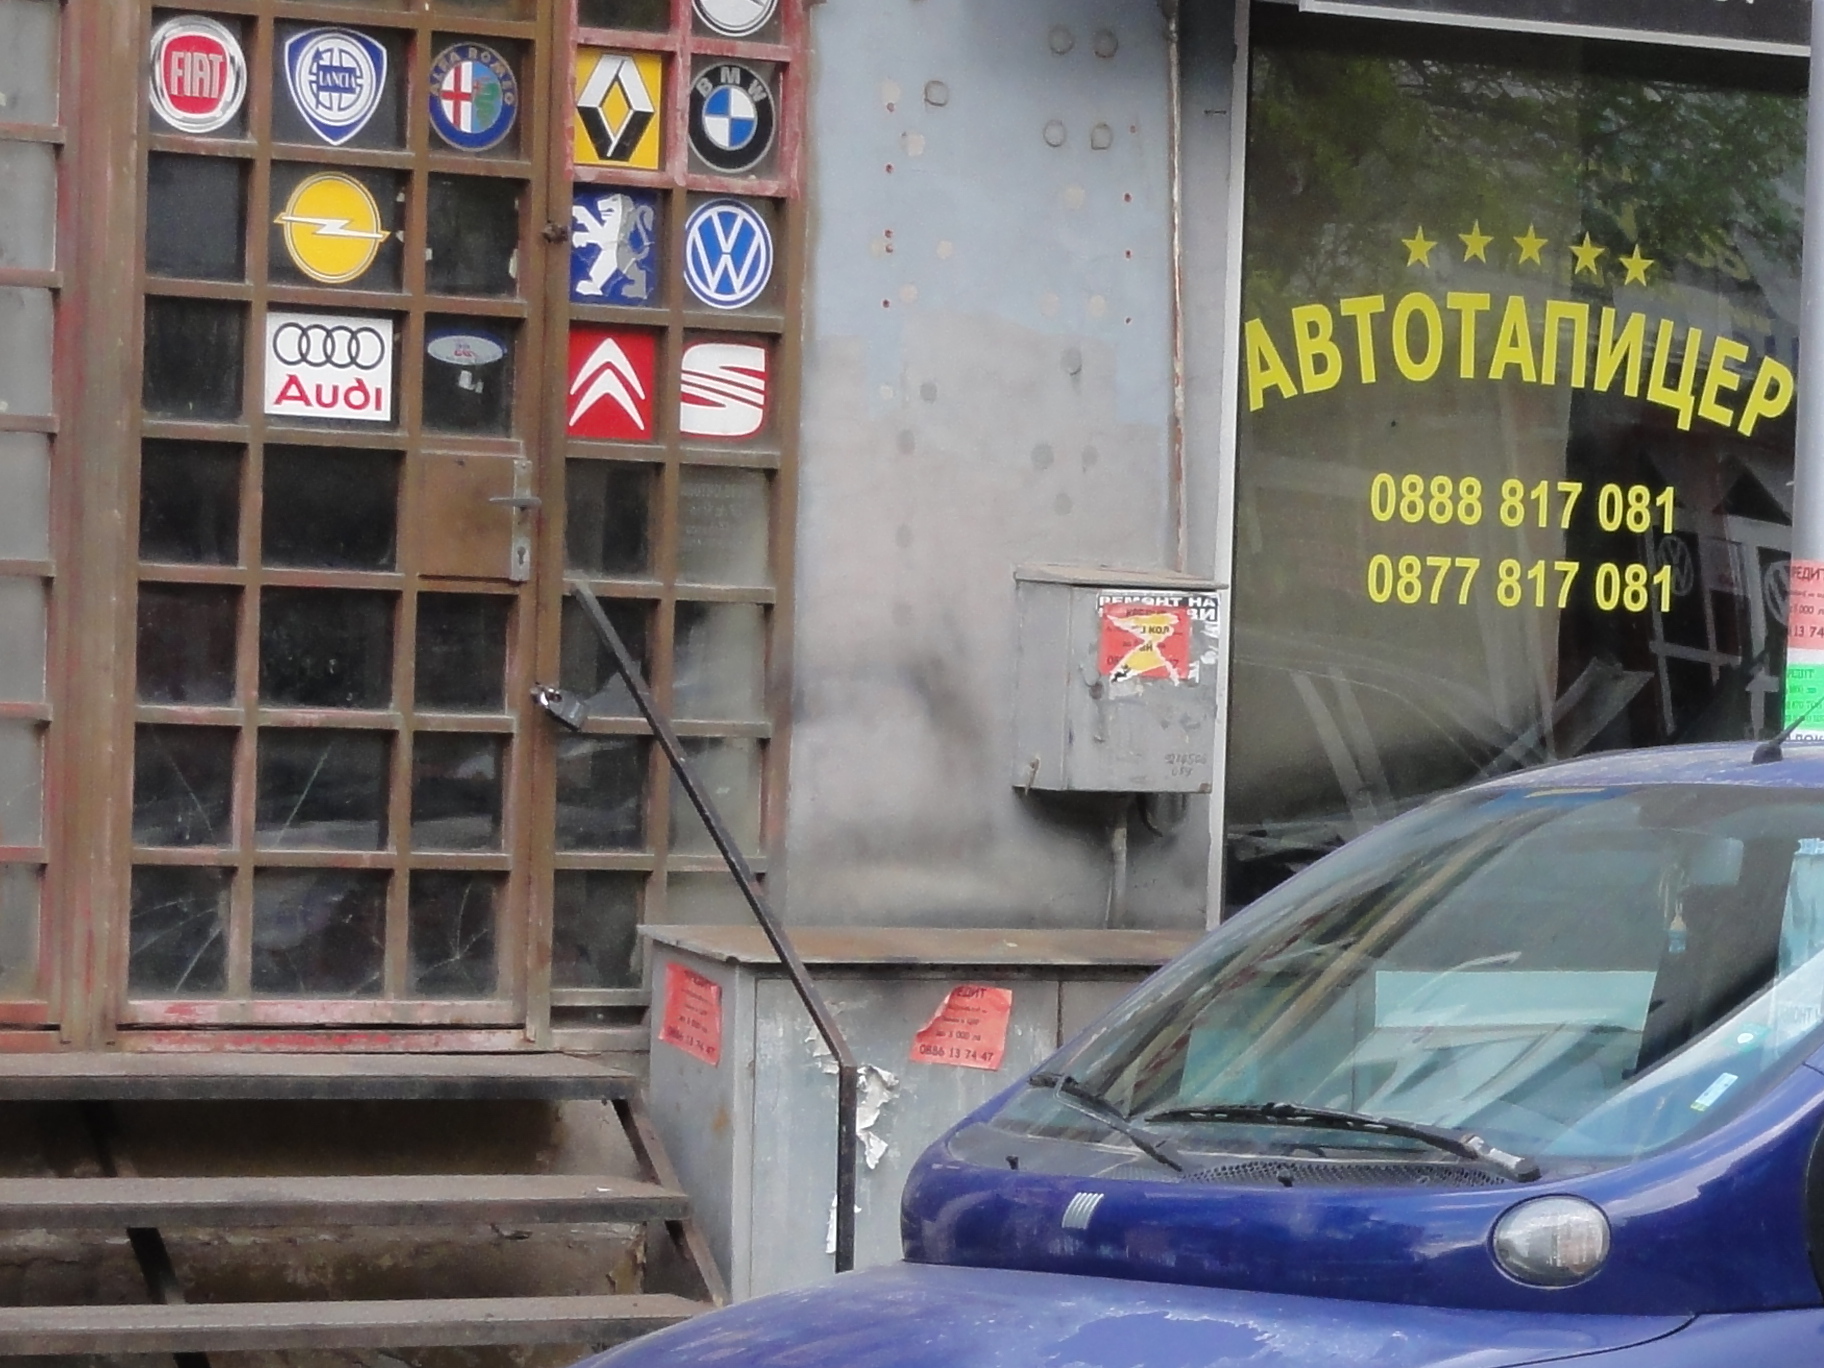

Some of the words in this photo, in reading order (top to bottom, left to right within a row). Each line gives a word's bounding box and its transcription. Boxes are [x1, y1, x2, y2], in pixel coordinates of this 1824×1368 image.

[171, 51, 224, 99] FIAT
[318, 70, 357, 89] LANCIA
[695, 65, 768, 102] BMW
[1244, 291, 1795, 437] АВТОТАПИЦЕР
[273, 373, 383, 412] Audi
[1370, 472, 1483, 526] 0888
[1499, 479, 1584, 530] 817
[1598, 484, 1675, 535] 081
[1188, 597, 1216, 607] НА
[1367, 553, 1480, 606] 0877
[1497, 559, 1580, 609] 817
[1595, 563, 1672, 613] 081
[1809, 626, 1824, 638] 74
[949, 1046, 961, 1059] 13
[965, 1048, 978, 1060] 74
[980, 1051, 994, 1062] 47
